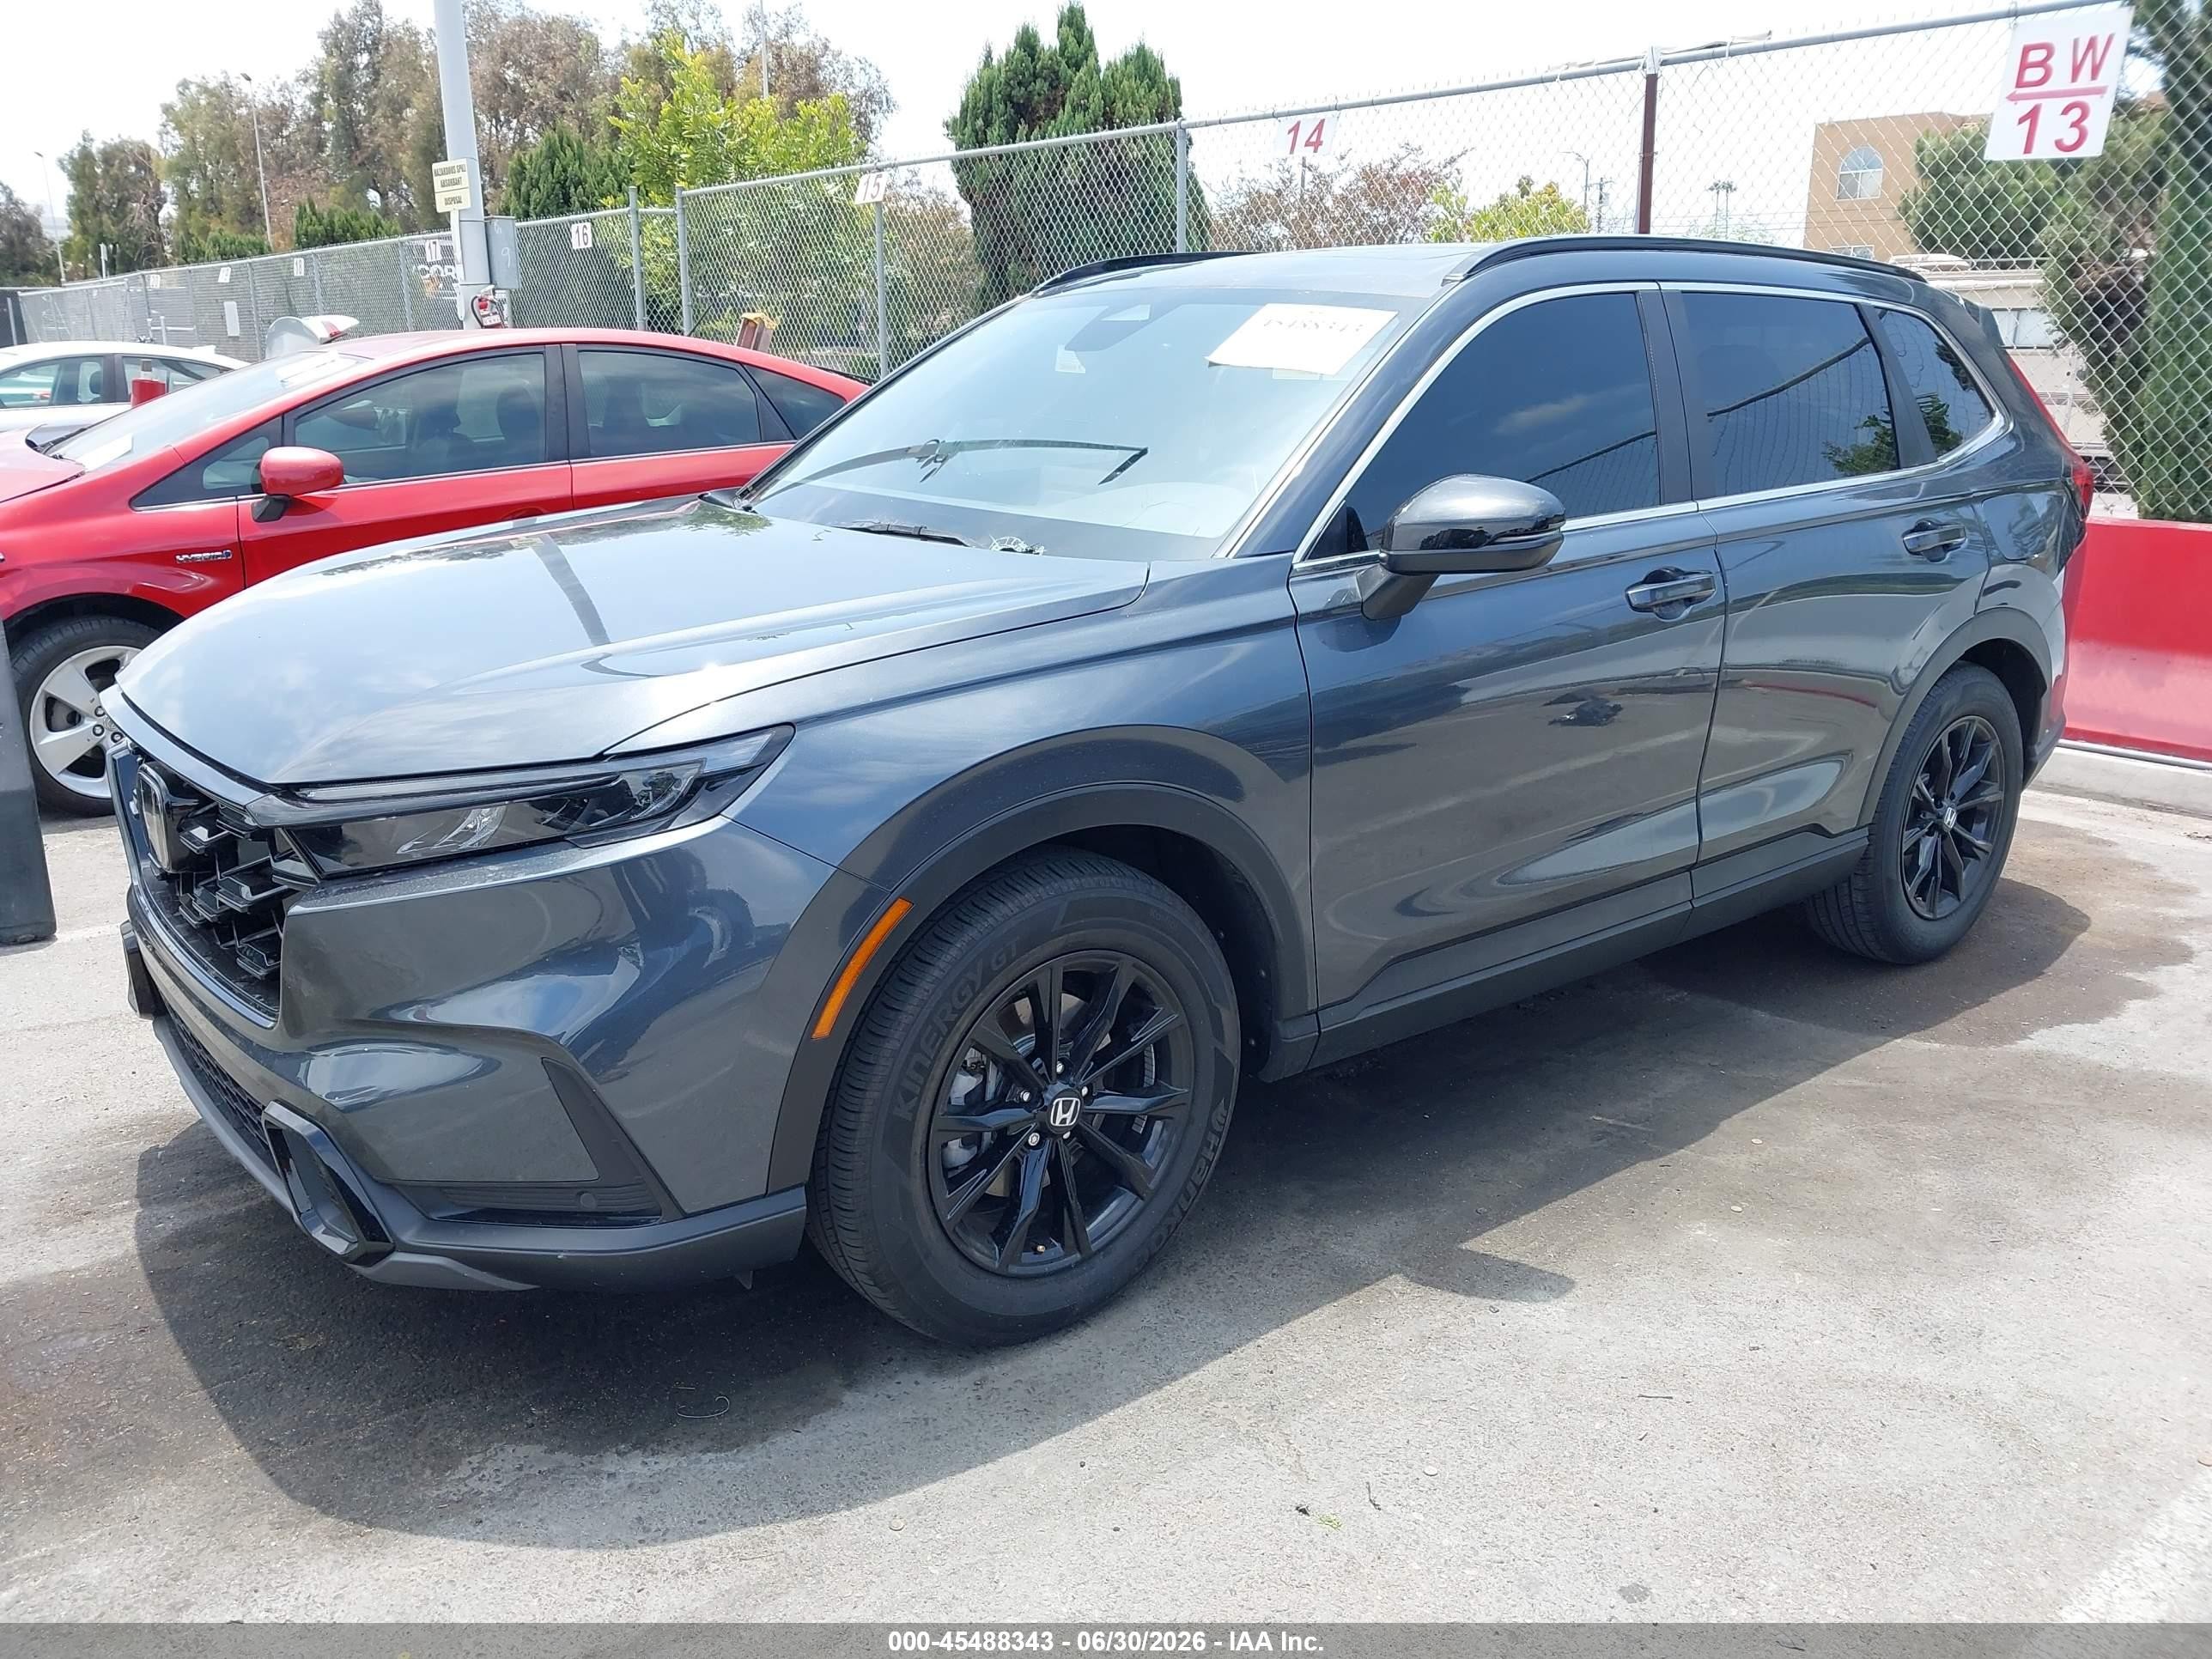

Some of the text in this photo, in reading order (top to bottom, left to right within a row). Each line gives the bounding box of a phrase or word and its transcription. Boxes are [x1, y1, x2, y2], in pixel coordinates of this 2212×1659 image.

[1287, 118, 1326, 155] 14
[2017, 100, 2091, 155] 13
[862, 173, 883, 201] 15
[444, 196, 463, 206] DISPOSAL
[575, 224, 589, 247] 16
[428, 240, 437, 261] 17
